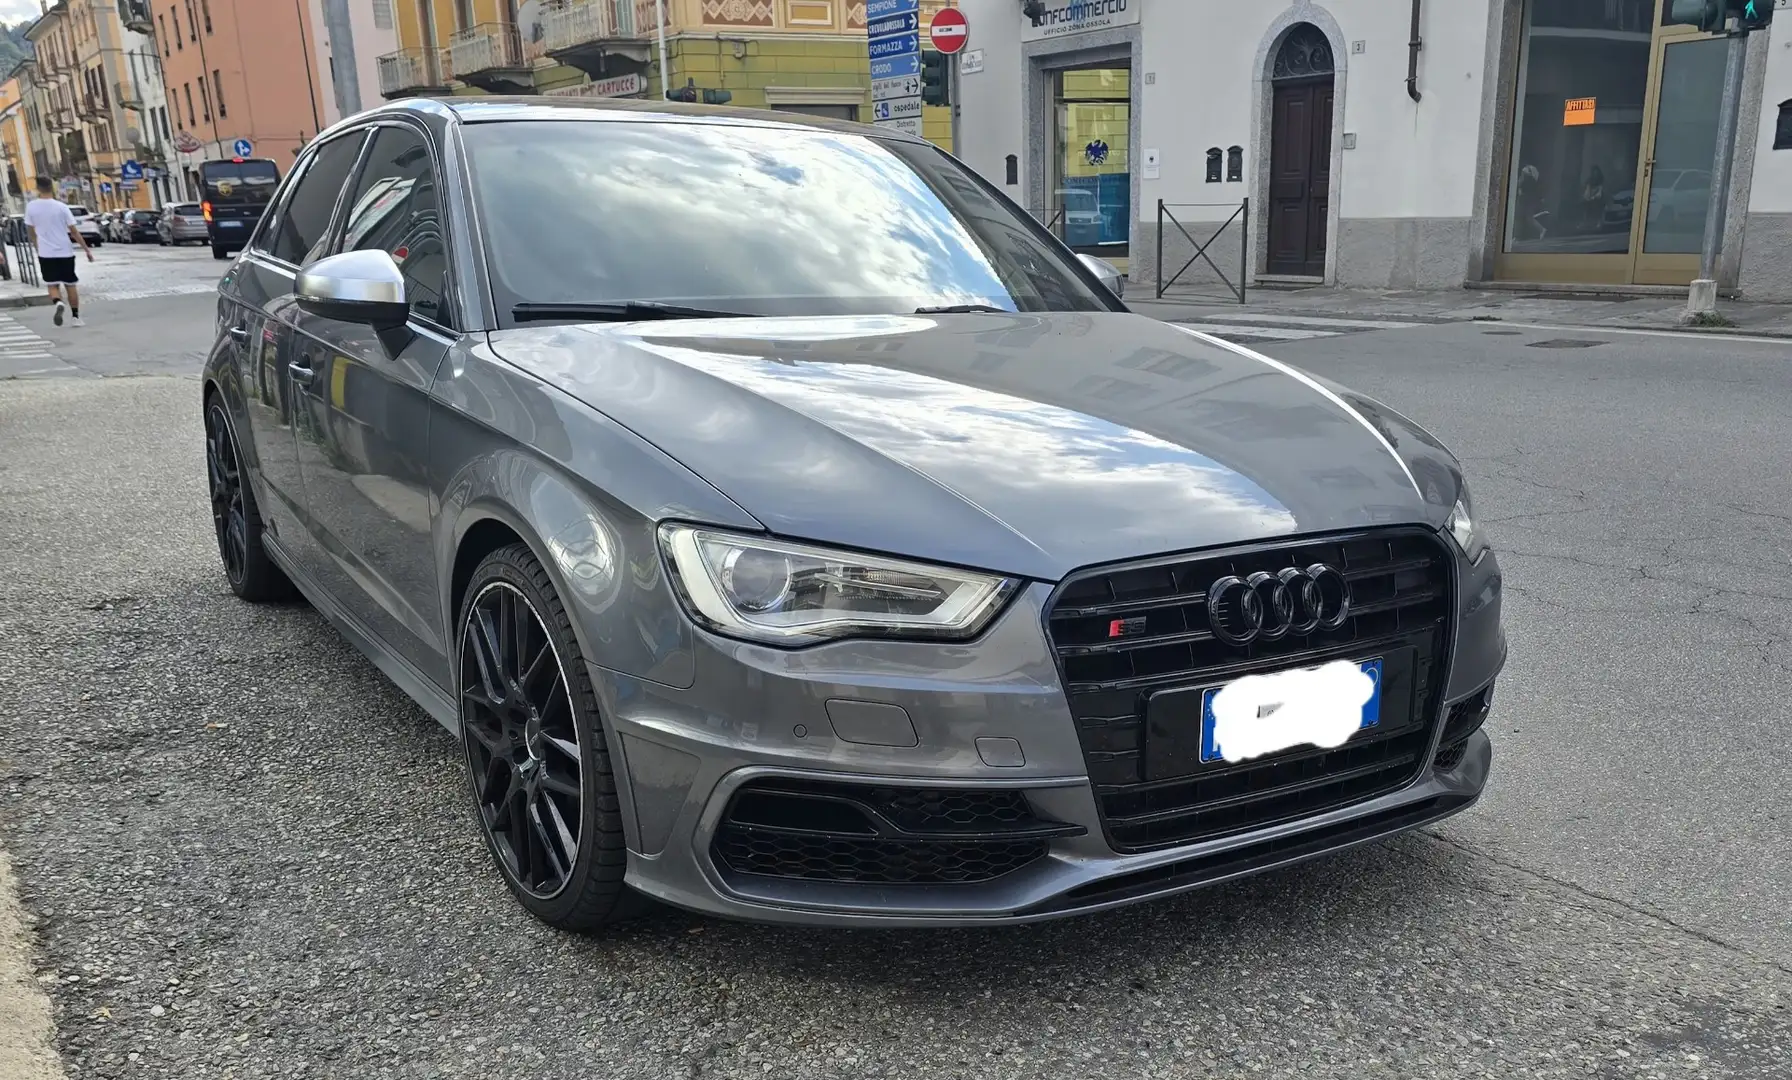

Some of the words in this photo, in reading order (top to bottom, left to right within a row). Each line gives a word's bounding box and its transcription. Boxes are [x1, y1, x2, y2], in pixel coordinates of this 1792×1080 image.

[868, 0, 897, 13] SEMPIONE
[1043, 26, 1067, 35] UFFICIO
[1068, 23, 1085, 31] ZONA
[1086, 19, 1111, 29] OSSOLA
[869, 40, 903, 55] FORMAZZA
[871, 63, 892, 75] CRODO
[597, 78, 635, 95] CARTUCCE
[893, 101, 920, 112] ospedale
